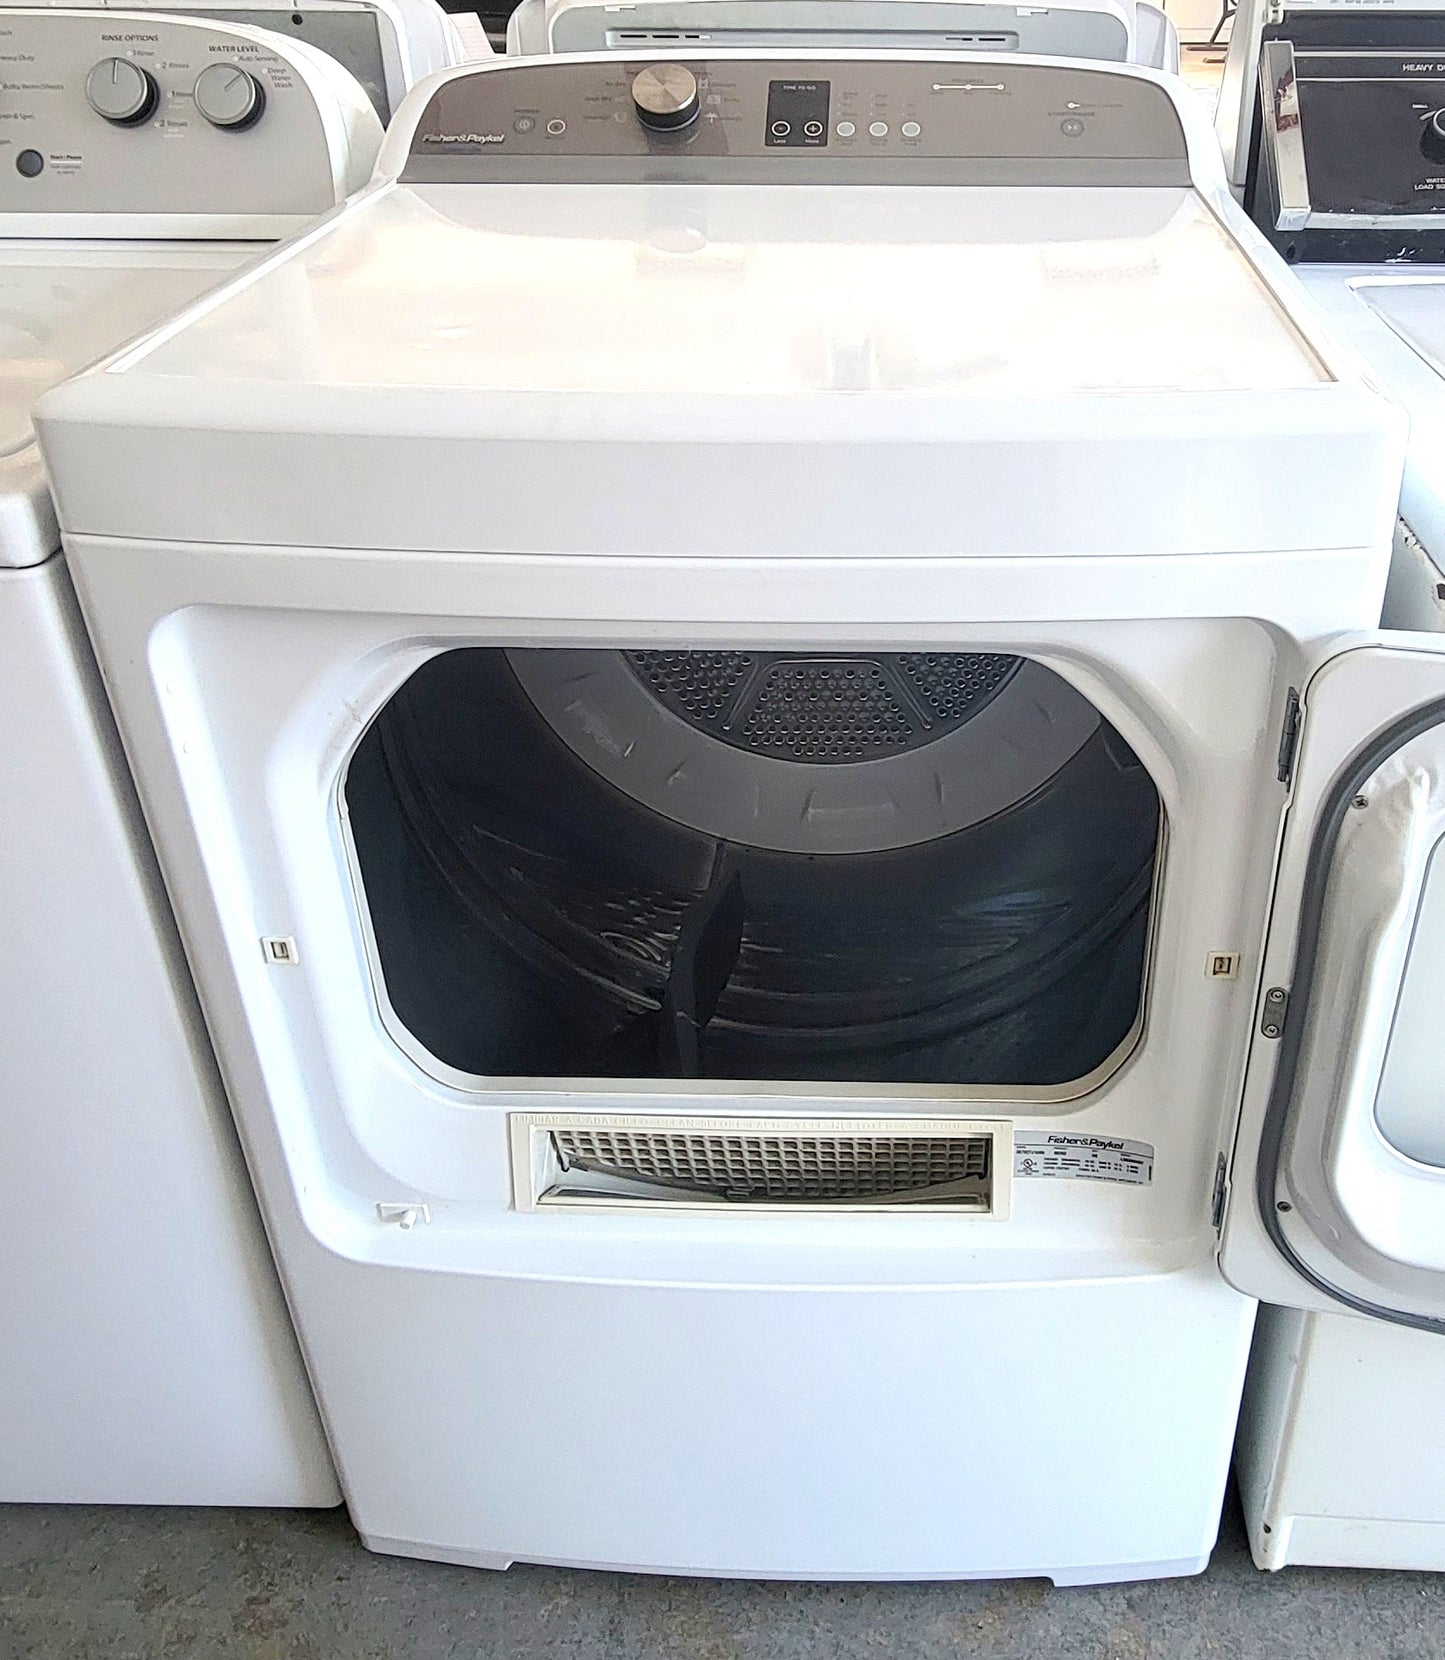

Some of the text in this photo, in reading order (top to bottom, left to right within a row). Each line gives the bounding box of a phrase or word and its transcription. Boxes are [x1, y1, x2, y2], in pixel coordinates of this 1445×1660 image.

[101, 34, 159, 42] RINSE OPTIONS
[208, 45, 236, 53] WATER
[268, 67, 287, 76] Deep
[1402, 63, 1434, 72] HEAVY
[1047, 1134, 1125, 1151] Fisher&Paykel
